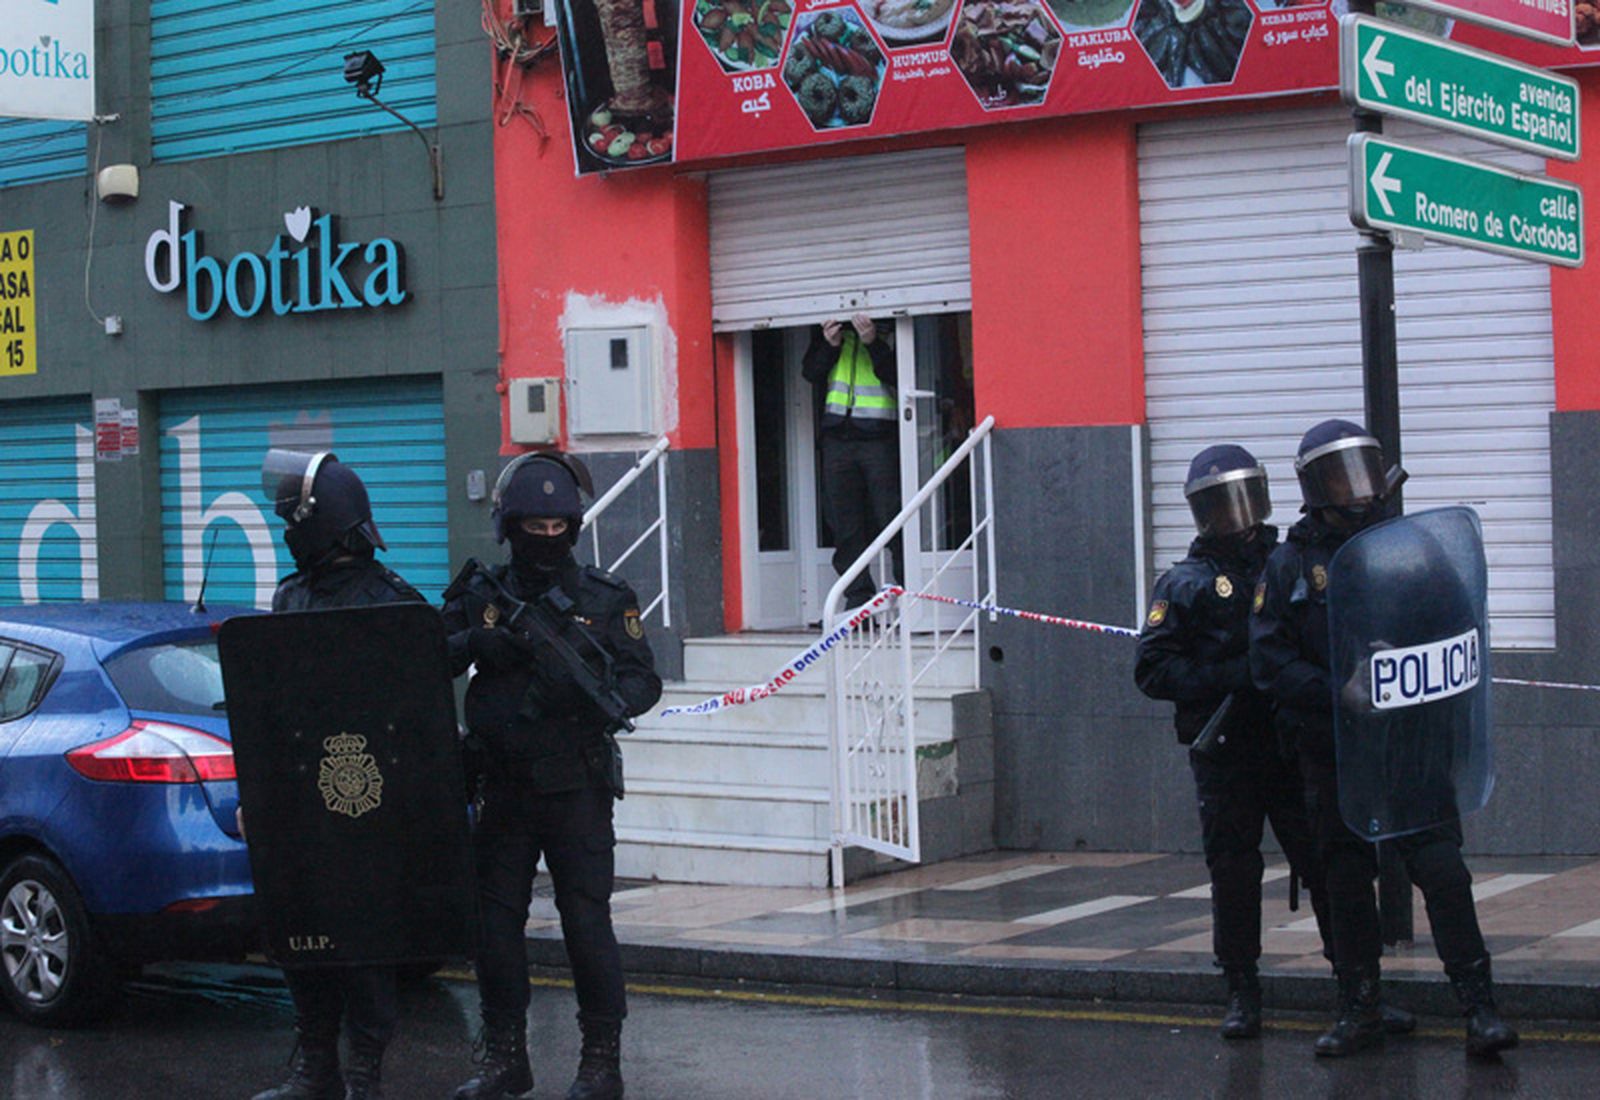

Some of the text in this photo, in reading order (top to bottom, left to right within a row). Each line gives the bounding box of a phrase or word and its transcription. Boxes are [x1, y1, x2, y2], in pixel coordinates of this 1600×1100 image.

[1261, 13, 1294, 26] KEBAB
[1069, 30, 1131, 48] MAKLUBA
[892, 50, 949, 68] HUMMUS
[732, 73, 776, 93] KOBA
[1405, 76, 1573, 145] del Ejército Español
[1519, 83, 1572, 115] avenida
[1539, 197, 1577, 221] calle
[1415, 192, 1577, 253] Romero de Córdoba
[18, 236, 29, 260] O
[0, 305, 25, 334] AL
[6, 339, 24, 368] 15
[1374, 636, 1478, 703] POLICIA
[723, 688, 745, 706] NO
[289, 935, 336, 951] U.I.P.
